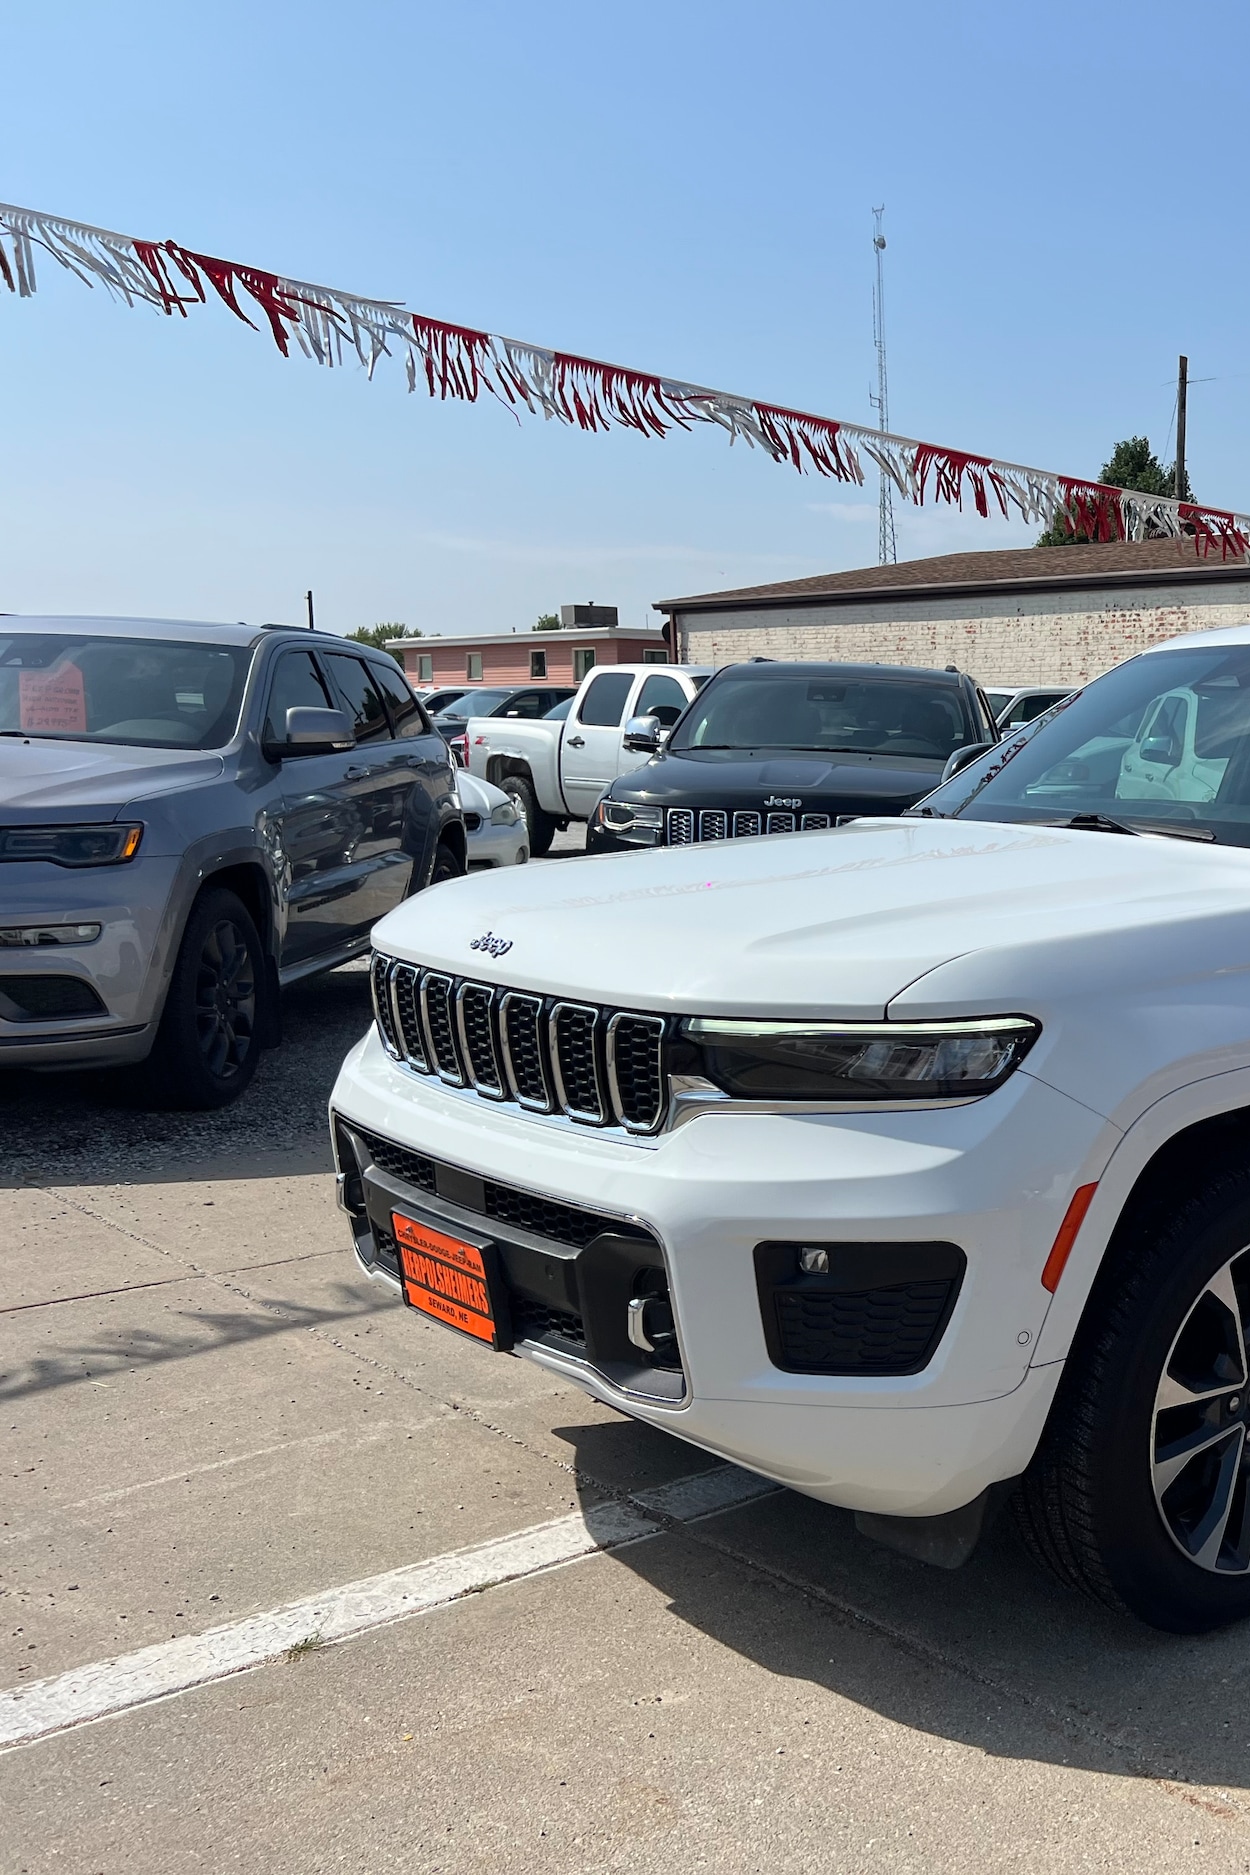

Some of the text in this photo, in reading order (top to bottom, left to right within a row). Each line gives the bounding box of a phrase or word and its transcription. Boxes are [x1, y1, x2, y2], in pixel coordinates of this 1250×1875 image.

[763, 795, 803, 809] Jeep
[470, 931, 513, 959] Jeep
[428, 1296, 469, 1324] SEWARD, NE
